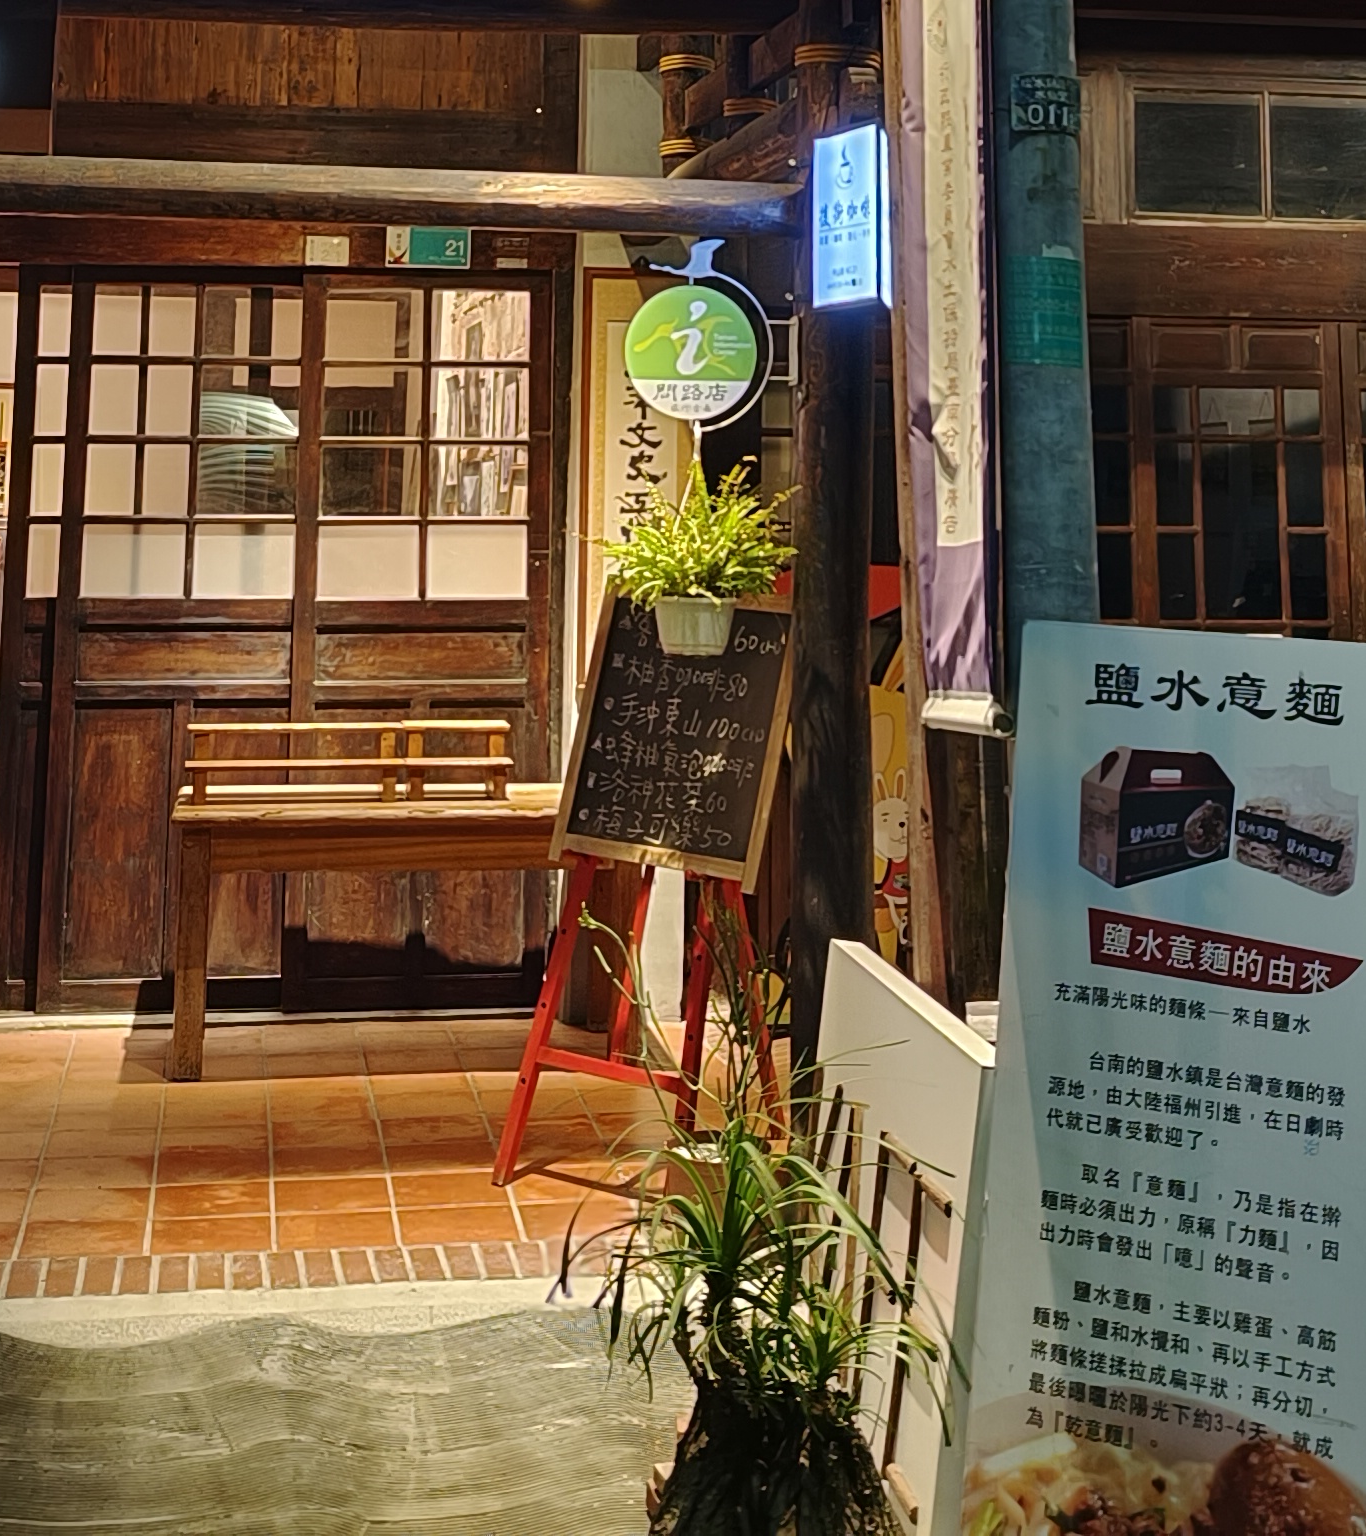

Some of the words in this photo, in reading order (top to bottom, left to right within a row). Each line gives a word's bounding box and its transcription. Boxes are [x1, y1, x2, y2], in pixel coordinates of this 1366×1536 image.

[445, 239, 464, 256] 21
[653, 383, 728, 402] 問路店
[1085, 663, 1344, 726] 鹽水意麵
[1100, 923, 1332, 993] 鹽水意麵的由來
[1088, 1051, 1346, 1108] 台南的鹽水鎮是台灣意麵的發
[1045, 1108, 1219, 1151] 代就已廣受歡迎了。
